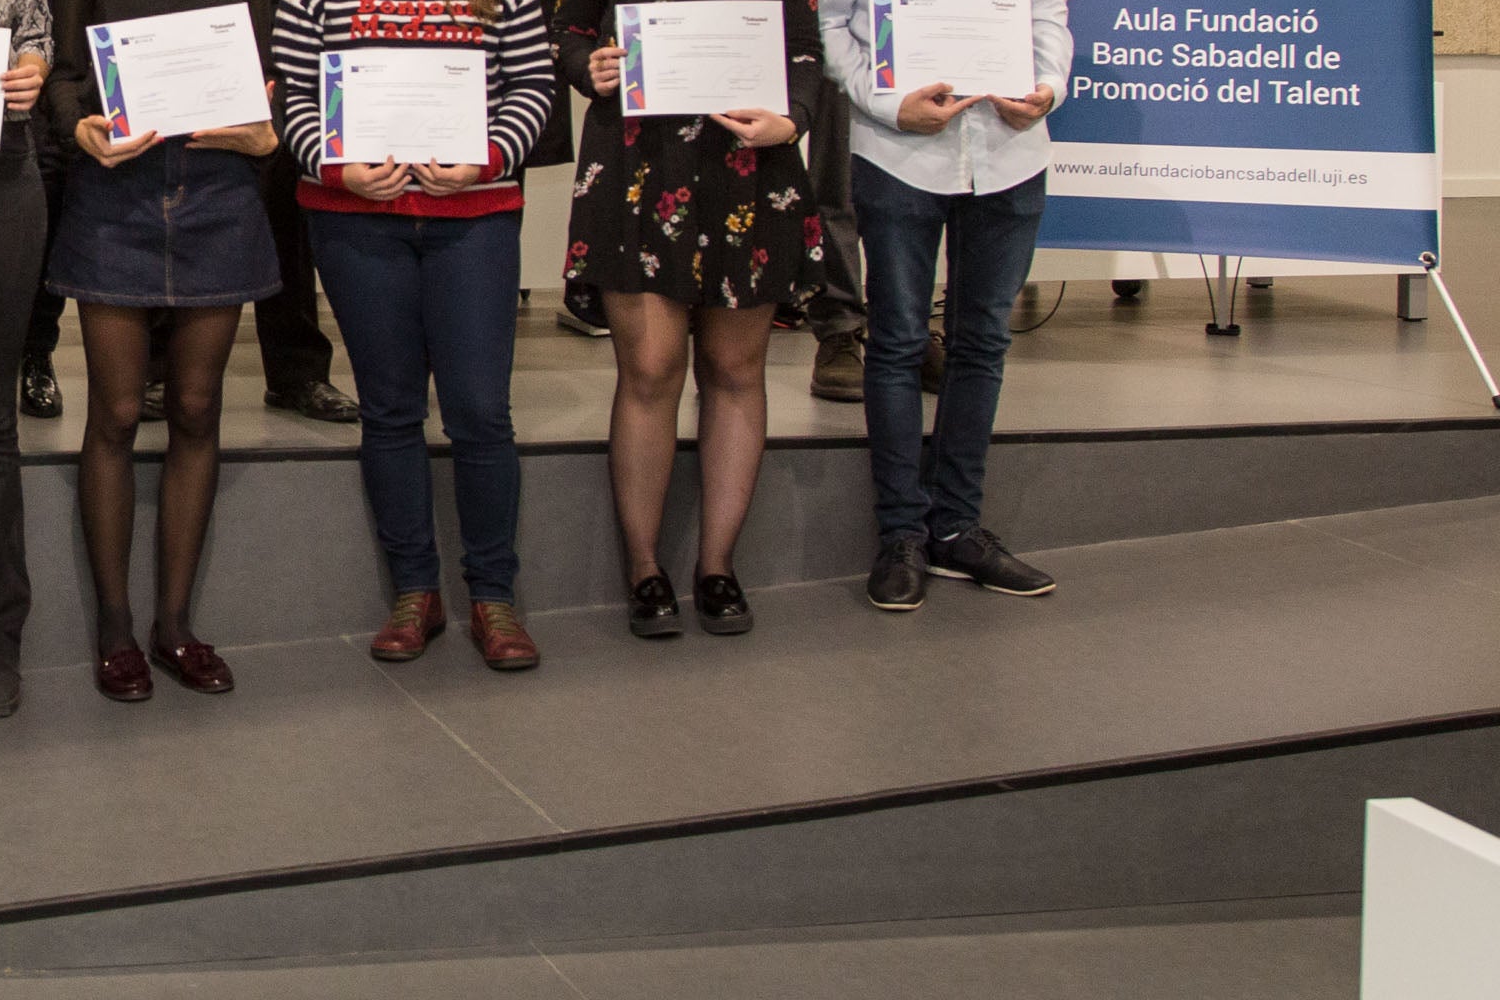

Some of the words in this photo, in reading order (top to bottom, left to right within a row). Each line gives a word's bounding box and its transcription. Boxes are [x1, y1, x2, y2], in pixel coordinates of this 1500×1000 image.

[350, 14, 484, 44] Madame
[1113, 7, 1176, 32] Aula
[1185, 8, 1319, 34] Fundació
[1092, 42, 1163, 67] Banc
[1171, 43, 1296, 69] Sabadell
[1304, 45, 1341, 70] de
[1072, 76, 1209, 103] Promoció
[1217, 78, 1260, 104] del
[1268, 81, 1361, 106] Talent
[1053, 162, 1368, 187] www.aulafundaciobancsabadell.uji.es
